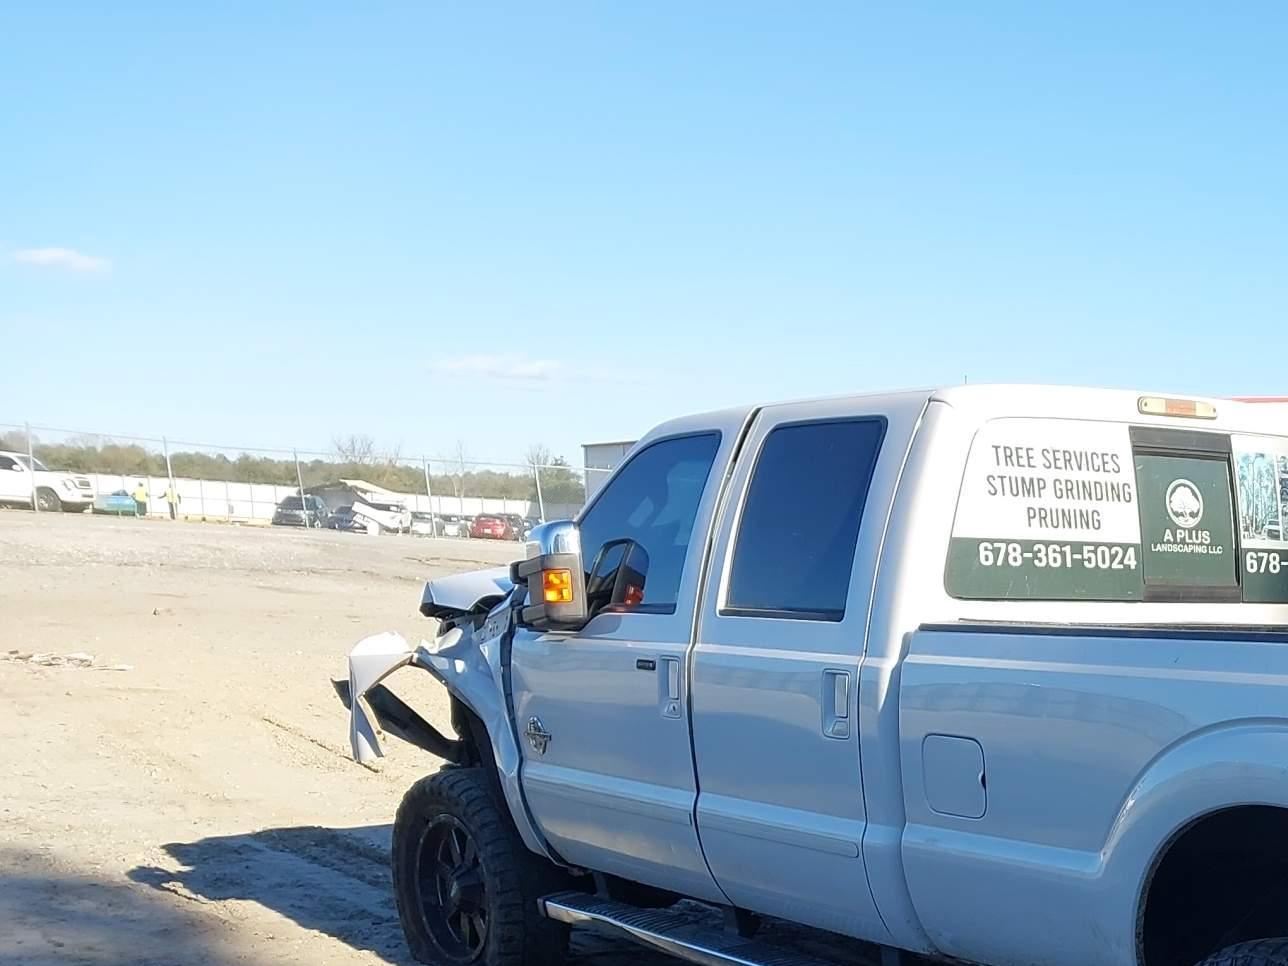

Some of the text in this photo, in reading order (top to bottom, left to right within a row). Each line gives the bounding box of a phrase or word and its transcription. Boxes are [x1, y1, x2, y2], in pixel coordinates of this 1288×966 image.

[992, 445, 1121, 474] TREE SERVICES
[986, 474, 1132, 503] STUMP GRINDING
[1027, 506, 1101, 530] PRUNING
[1151, 543, 1223, 554] LANDSCAPING LLC
[1163, 528, 1211, 544] A PLUS
[978, 542, 1137, 570] 678-361-5024
